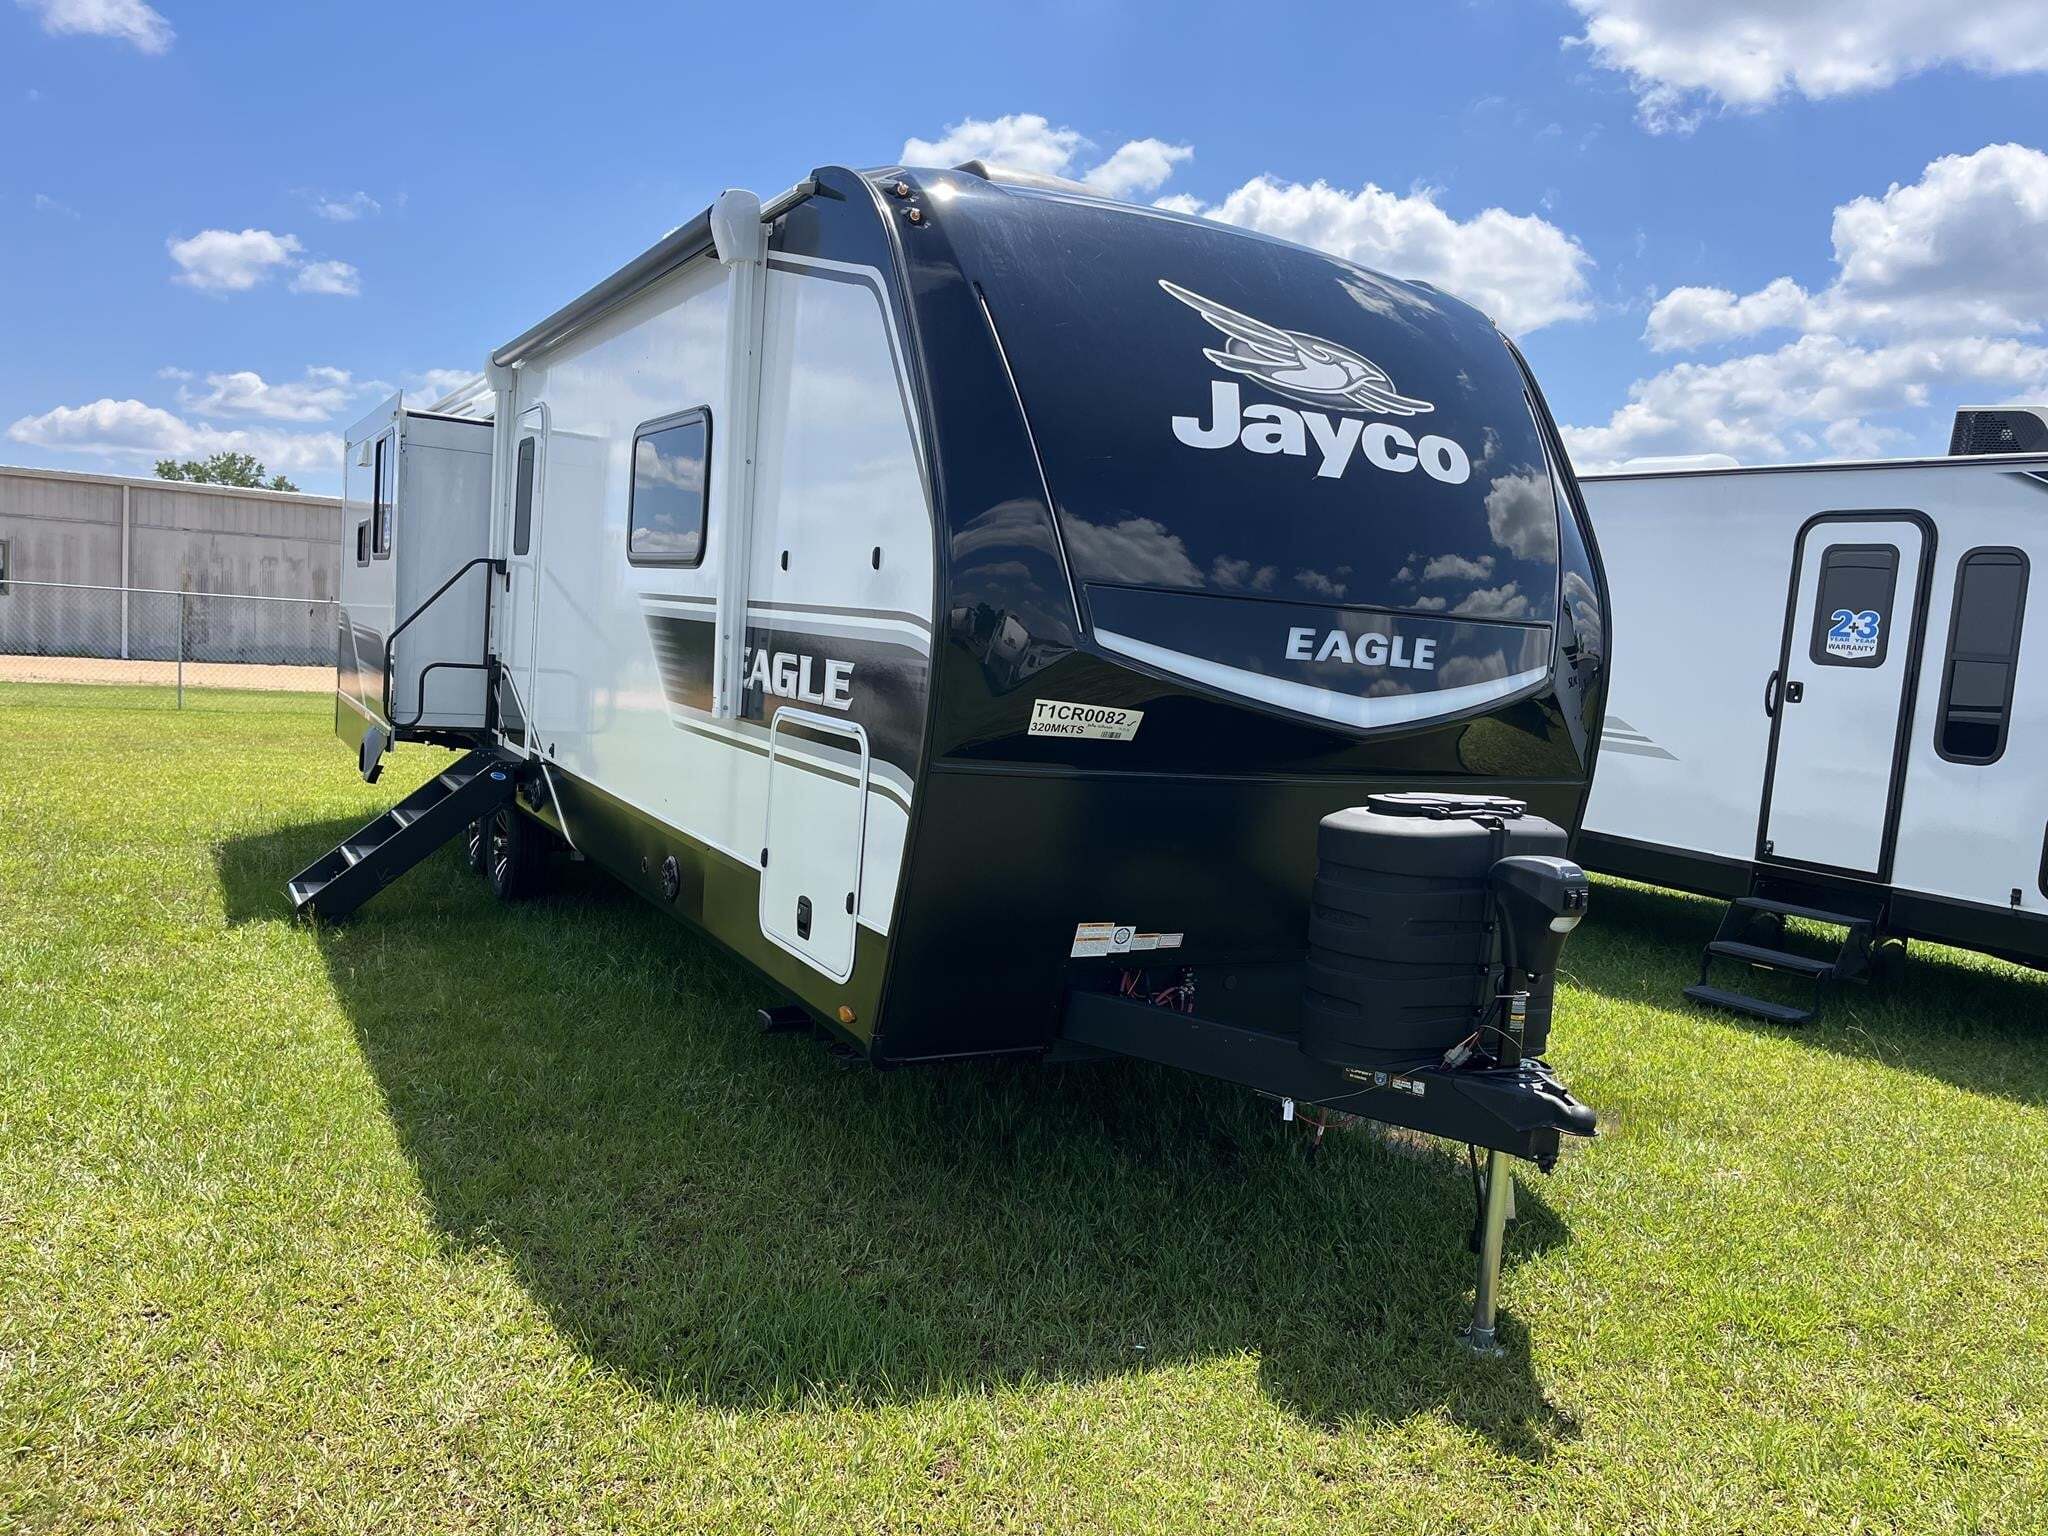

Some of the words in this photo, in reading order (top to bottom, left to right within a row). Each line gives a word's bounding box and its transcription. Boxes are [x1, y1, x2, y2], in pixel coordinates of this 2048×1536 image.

[1172, 380, 1471, 484] Jayco
[1285, 626, 1437, 671] EAGLE
[1828, 643, 1875, 652] WARRANTY
[1036, 703, 1127, 725] T1CR0082
[1030, 722, 1084, 734] 320MKTS
